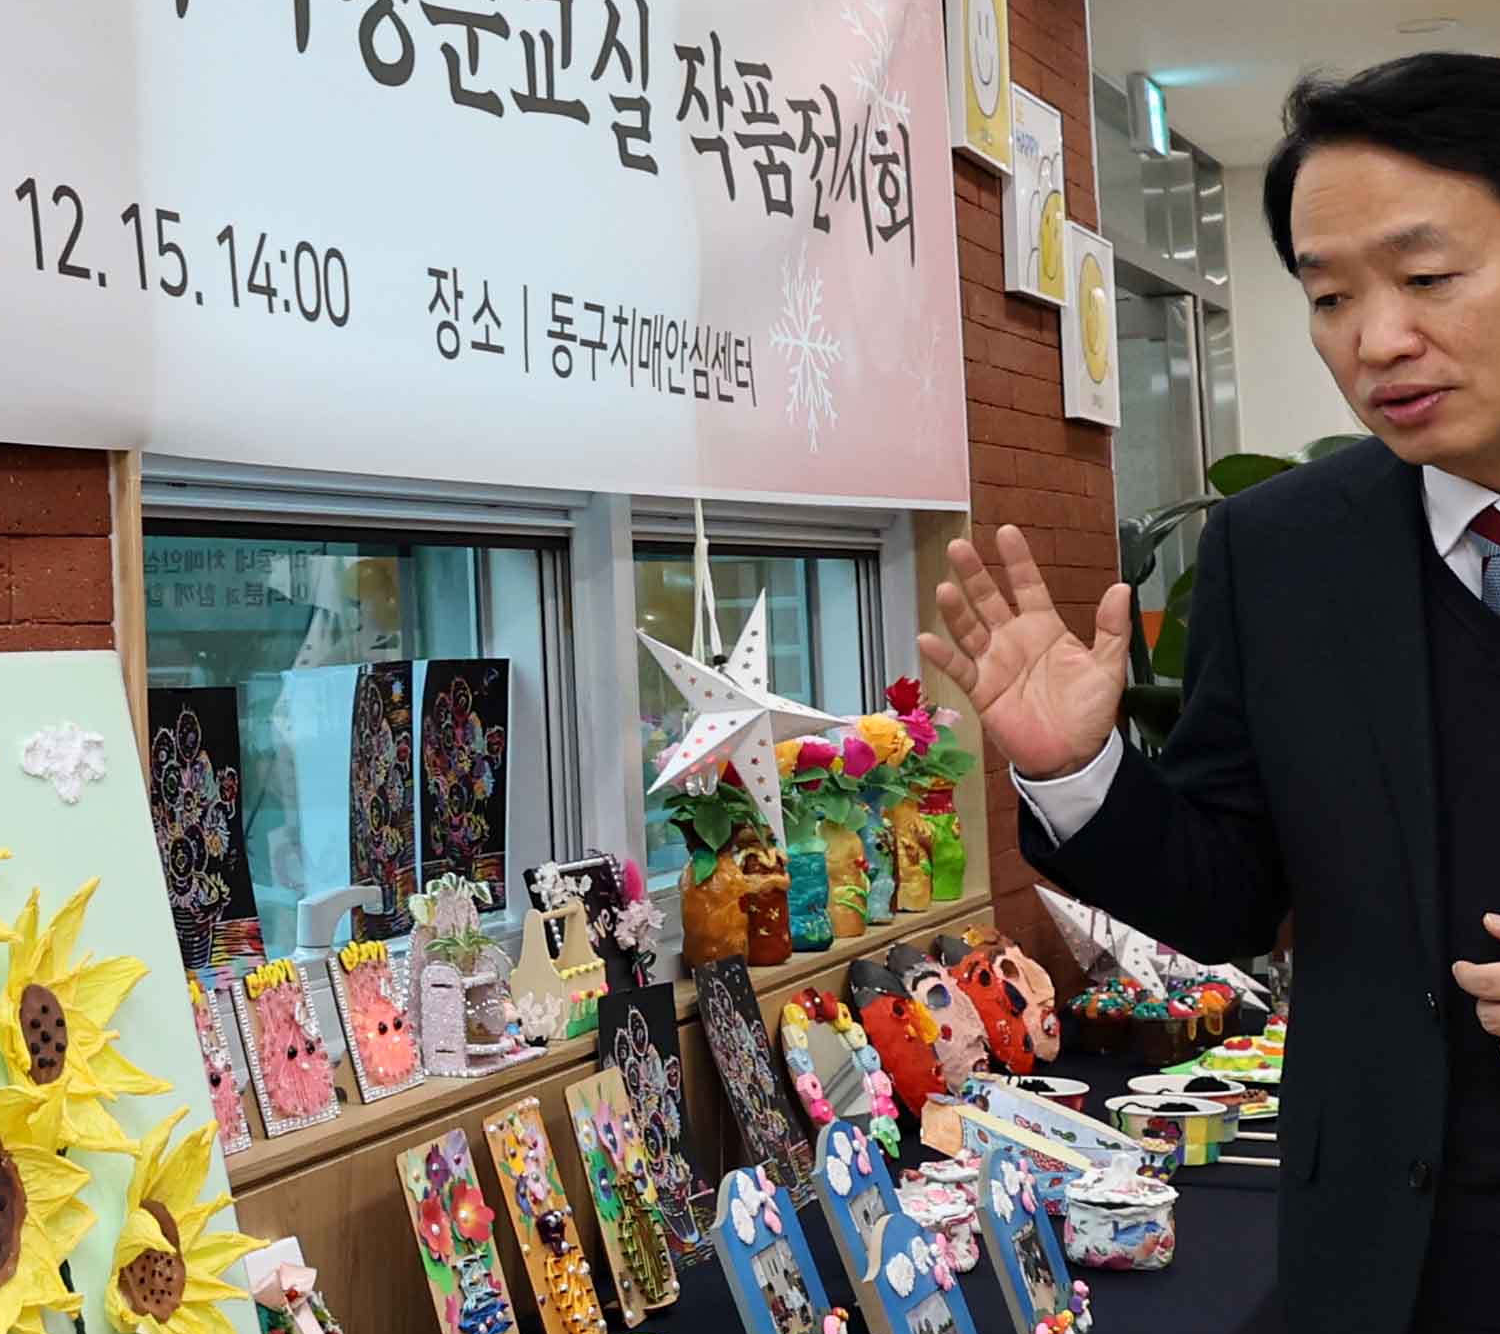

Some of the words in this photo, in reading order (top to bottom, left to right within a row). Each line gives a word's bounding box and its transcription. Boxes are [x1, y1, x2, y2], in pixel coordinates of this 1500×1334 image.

[674, 29, 916, 267] 작품전시회
[427, 265, 506, 364] 장소
[546, 293, 758, 406] 동구치매안심센터
